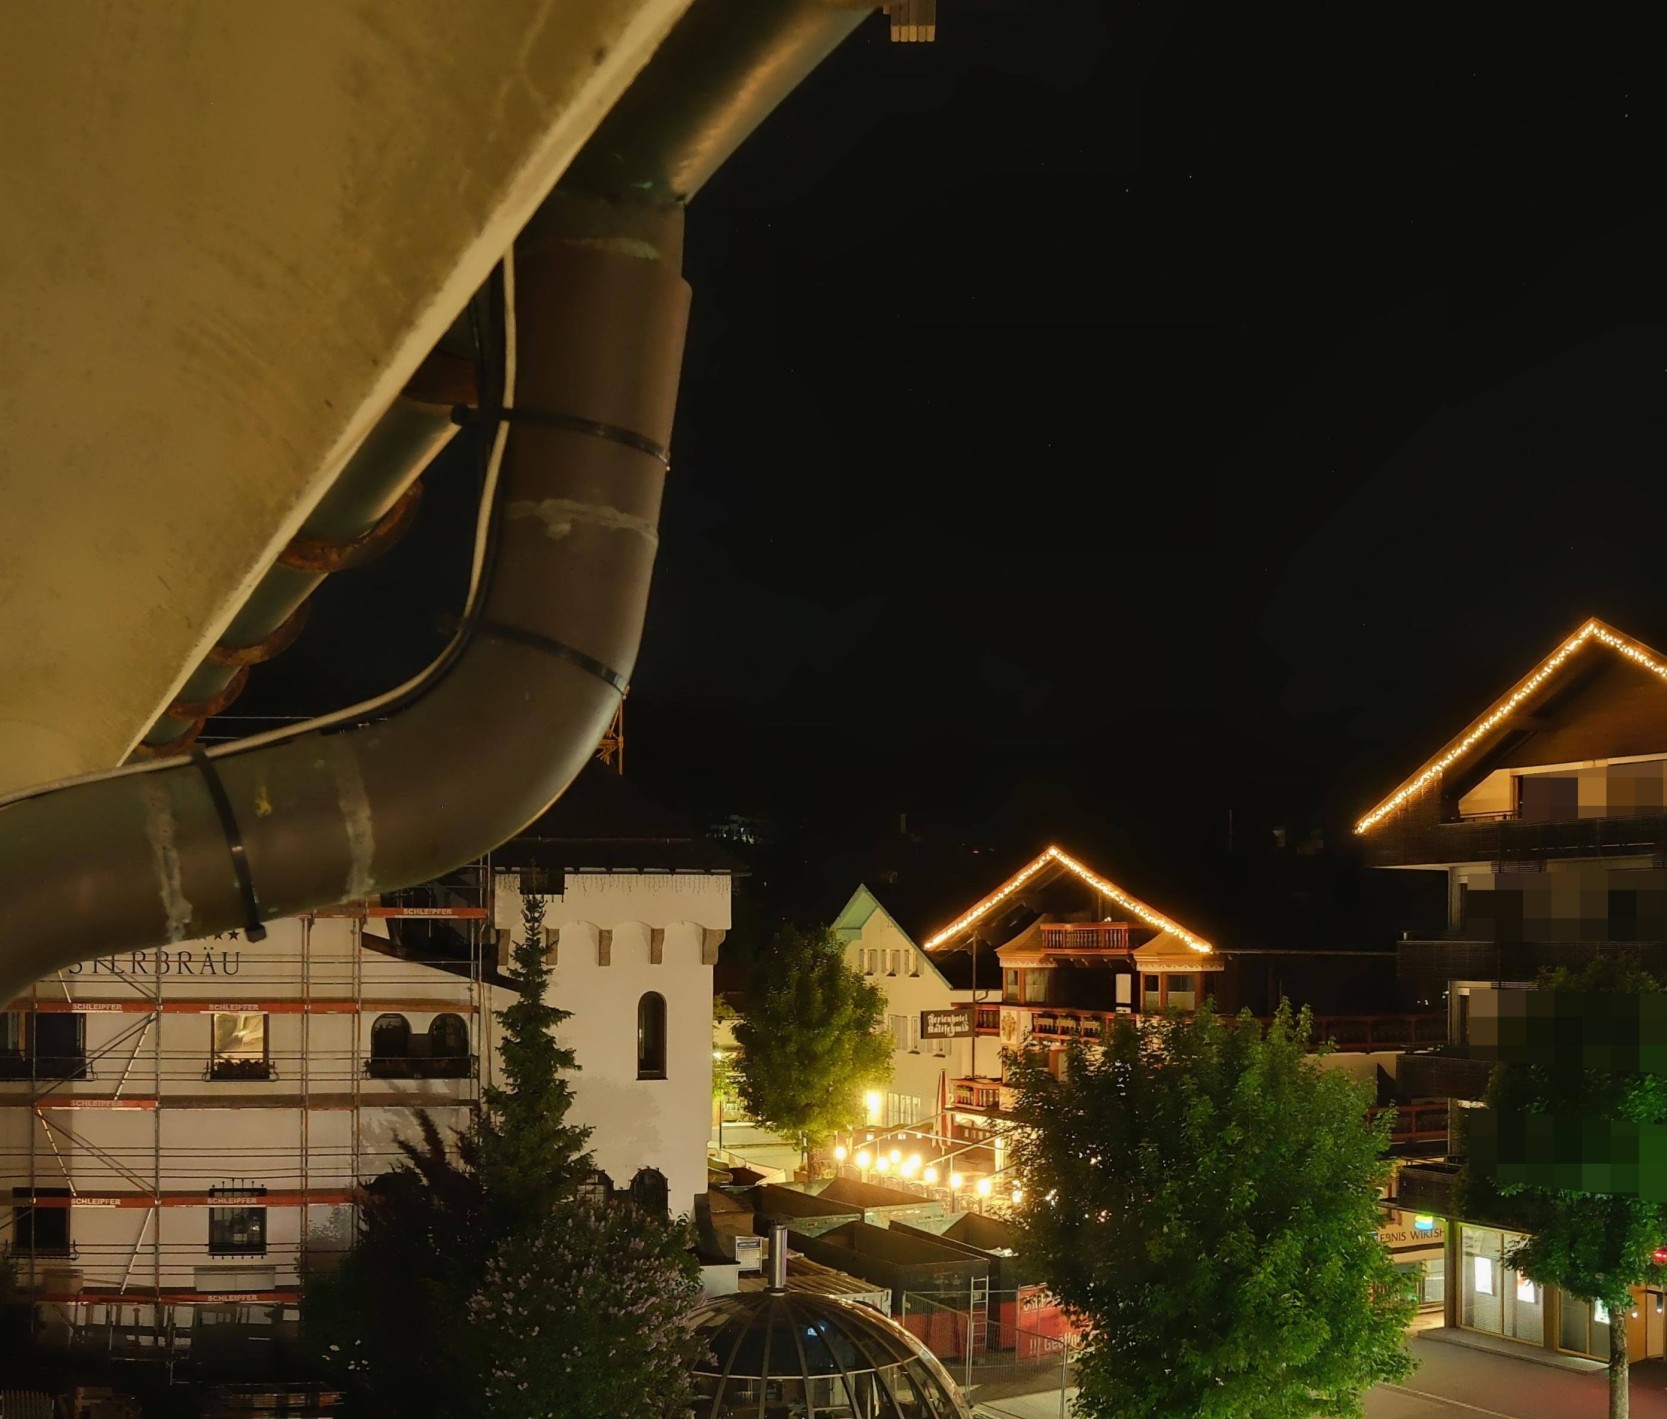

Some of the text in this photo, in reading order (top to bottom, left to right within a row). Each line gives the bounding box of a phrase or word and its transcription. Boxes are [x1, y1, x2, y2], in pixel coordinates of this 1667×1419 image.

[72, 1003, 122, 1011] SCHLEIPFER
[208, 1003, 259, 1011] SCHLEIPFER
[71, 1198, 121, 1206] SCHLEIPFER
